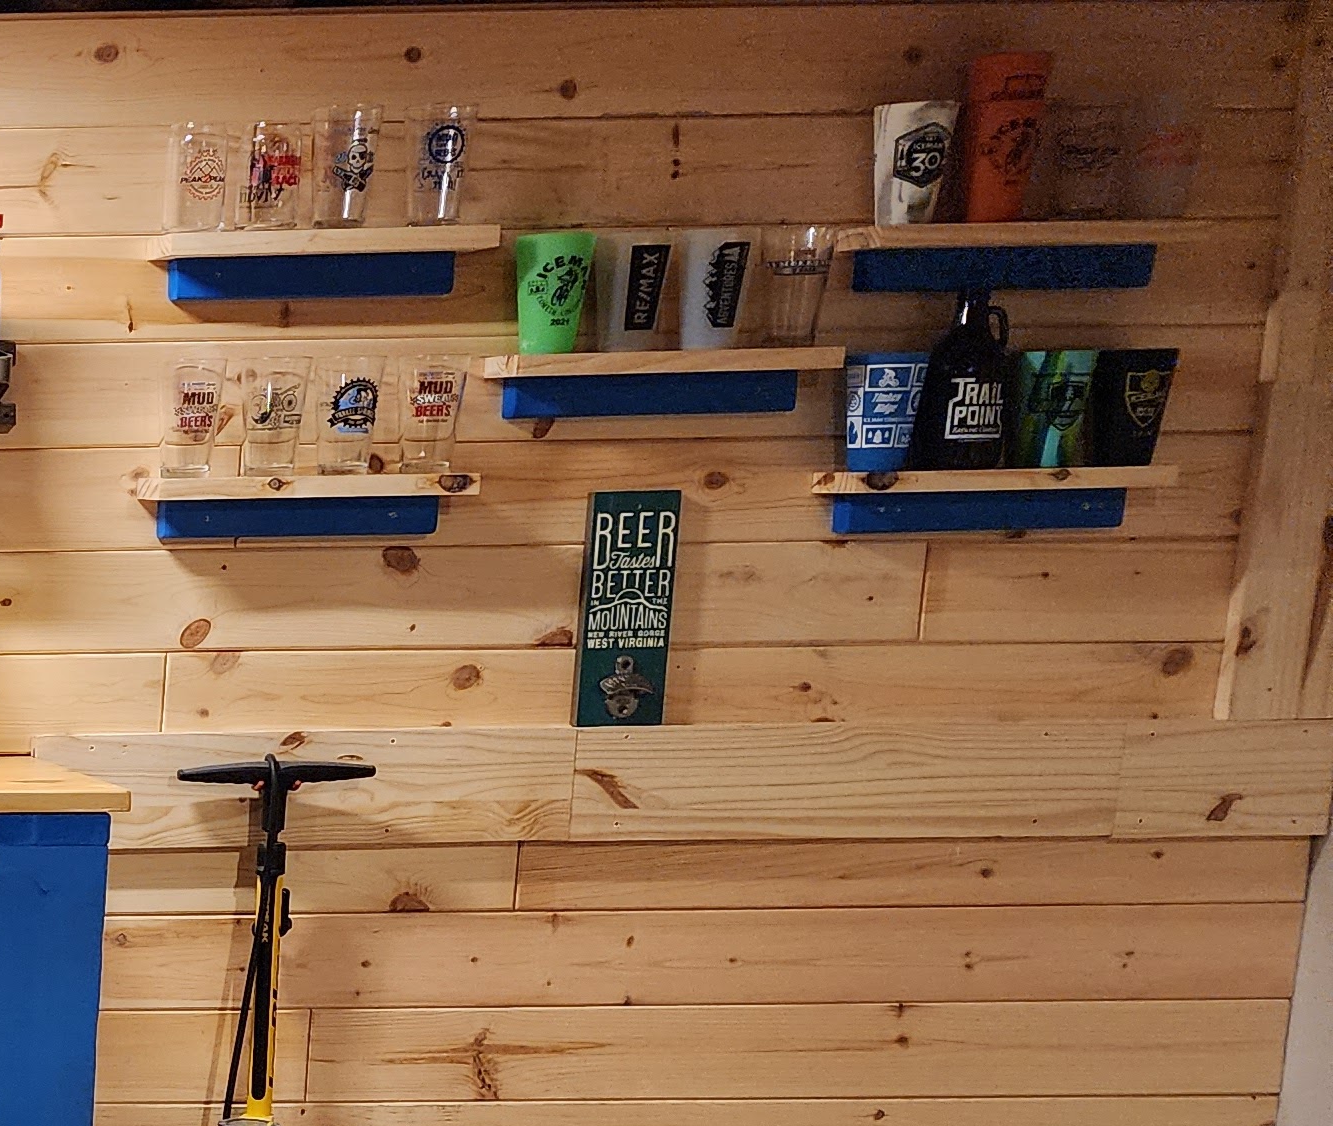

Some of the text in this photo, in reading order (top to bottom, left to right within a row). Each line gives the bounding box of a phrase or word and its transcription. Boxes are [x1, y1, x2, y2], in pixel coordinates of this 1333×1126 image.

[910, 151, 941, 177] 30
[634, 252, 660, 324] RE/MAX
[418, 380, 453, 395] MUD
[950, 377, 1003, 405] TRAIL
[182, 391, 215, 406] MUD
[413, 405, 452, 418] BEERS
[953, 405, 1003, 426] POINT
[179, 414, 213, 428] BEERS
[593, 511, 677, 570] BEER
[609, 551, 655, 569] Tastes
[591, 569, 671, 598] BETTER
[651, 597, 668, 605] THE
[587, 603, 668, 631] MOUNTAINS
[608, 630, 634, 638] RIVER
[637, 629, 666, 637] GORGE
[587, 637, 665, 649] WEST VIRGINIA
